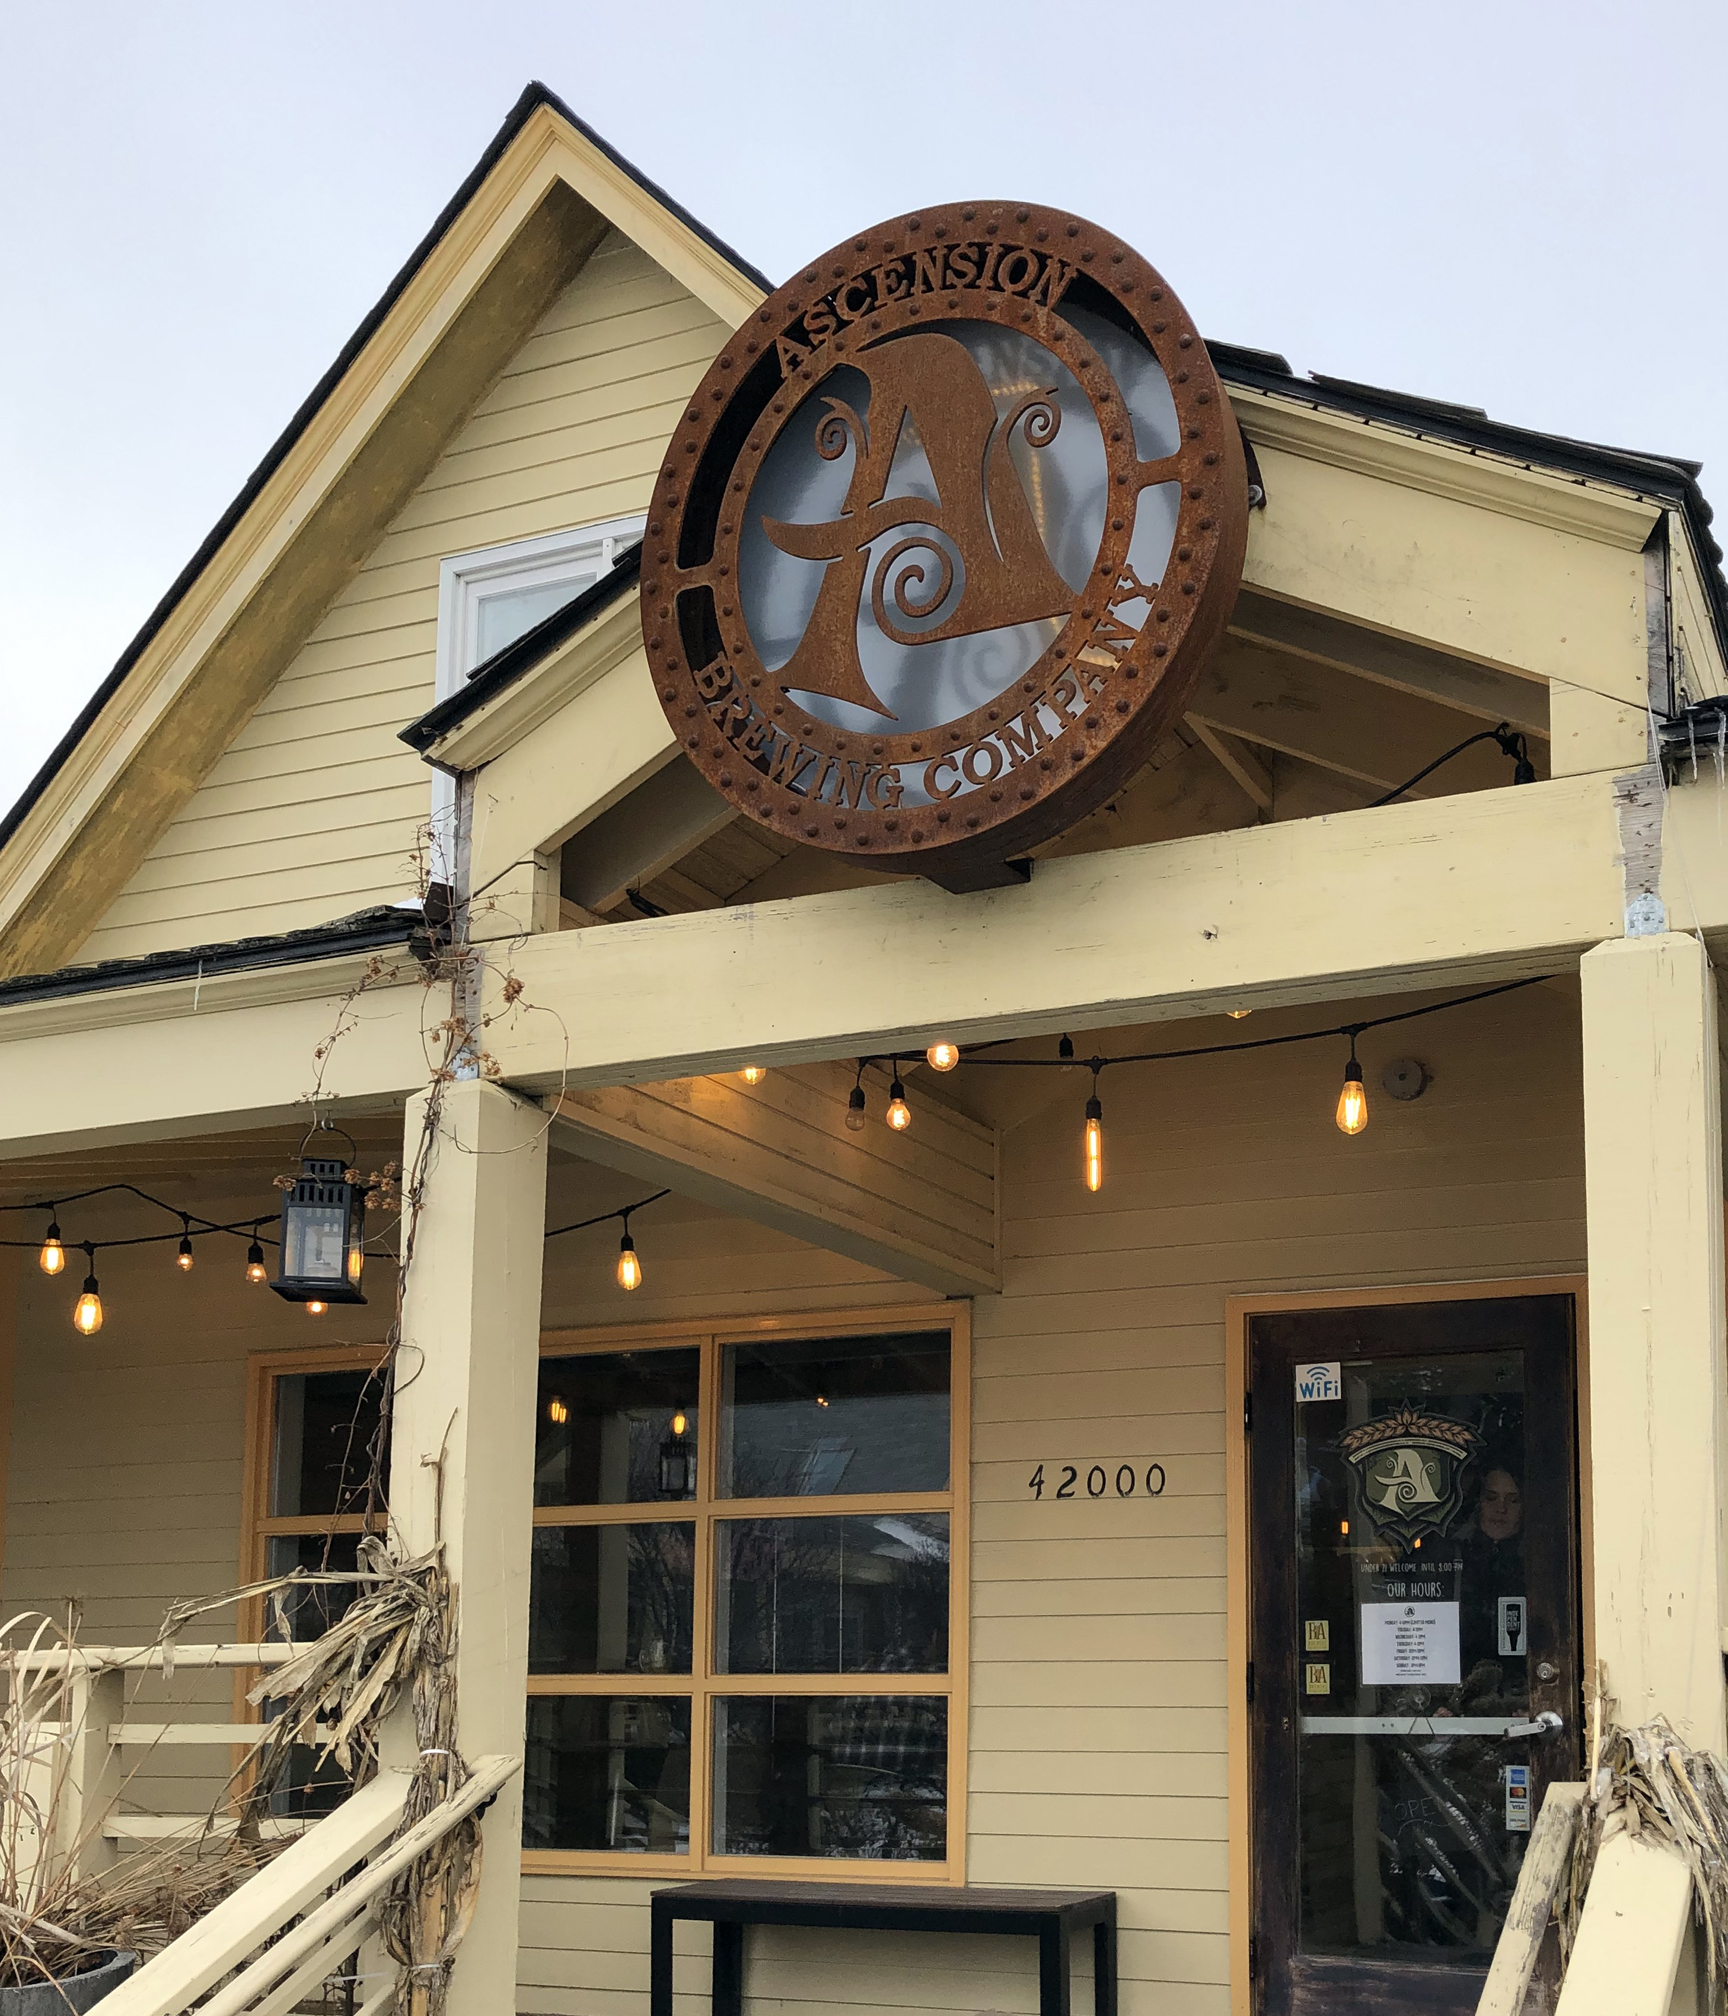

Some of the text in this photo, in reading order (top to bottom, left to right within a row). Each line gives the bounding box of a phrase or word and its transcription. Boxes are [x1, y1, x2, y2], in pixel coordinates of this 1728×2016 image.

[775, 242, 1079, 381] ASCENSION
[693, 563, 1161, 810] BREWING COMPANY
[1299, 1380, 1339, 1399] WiFi
[1028, 1463, 1166, 1501] 42000
[1389, 1563, 1417, 1573] WELCOME
[1387, 1582, 1445, 1598] OUR HOURS:
